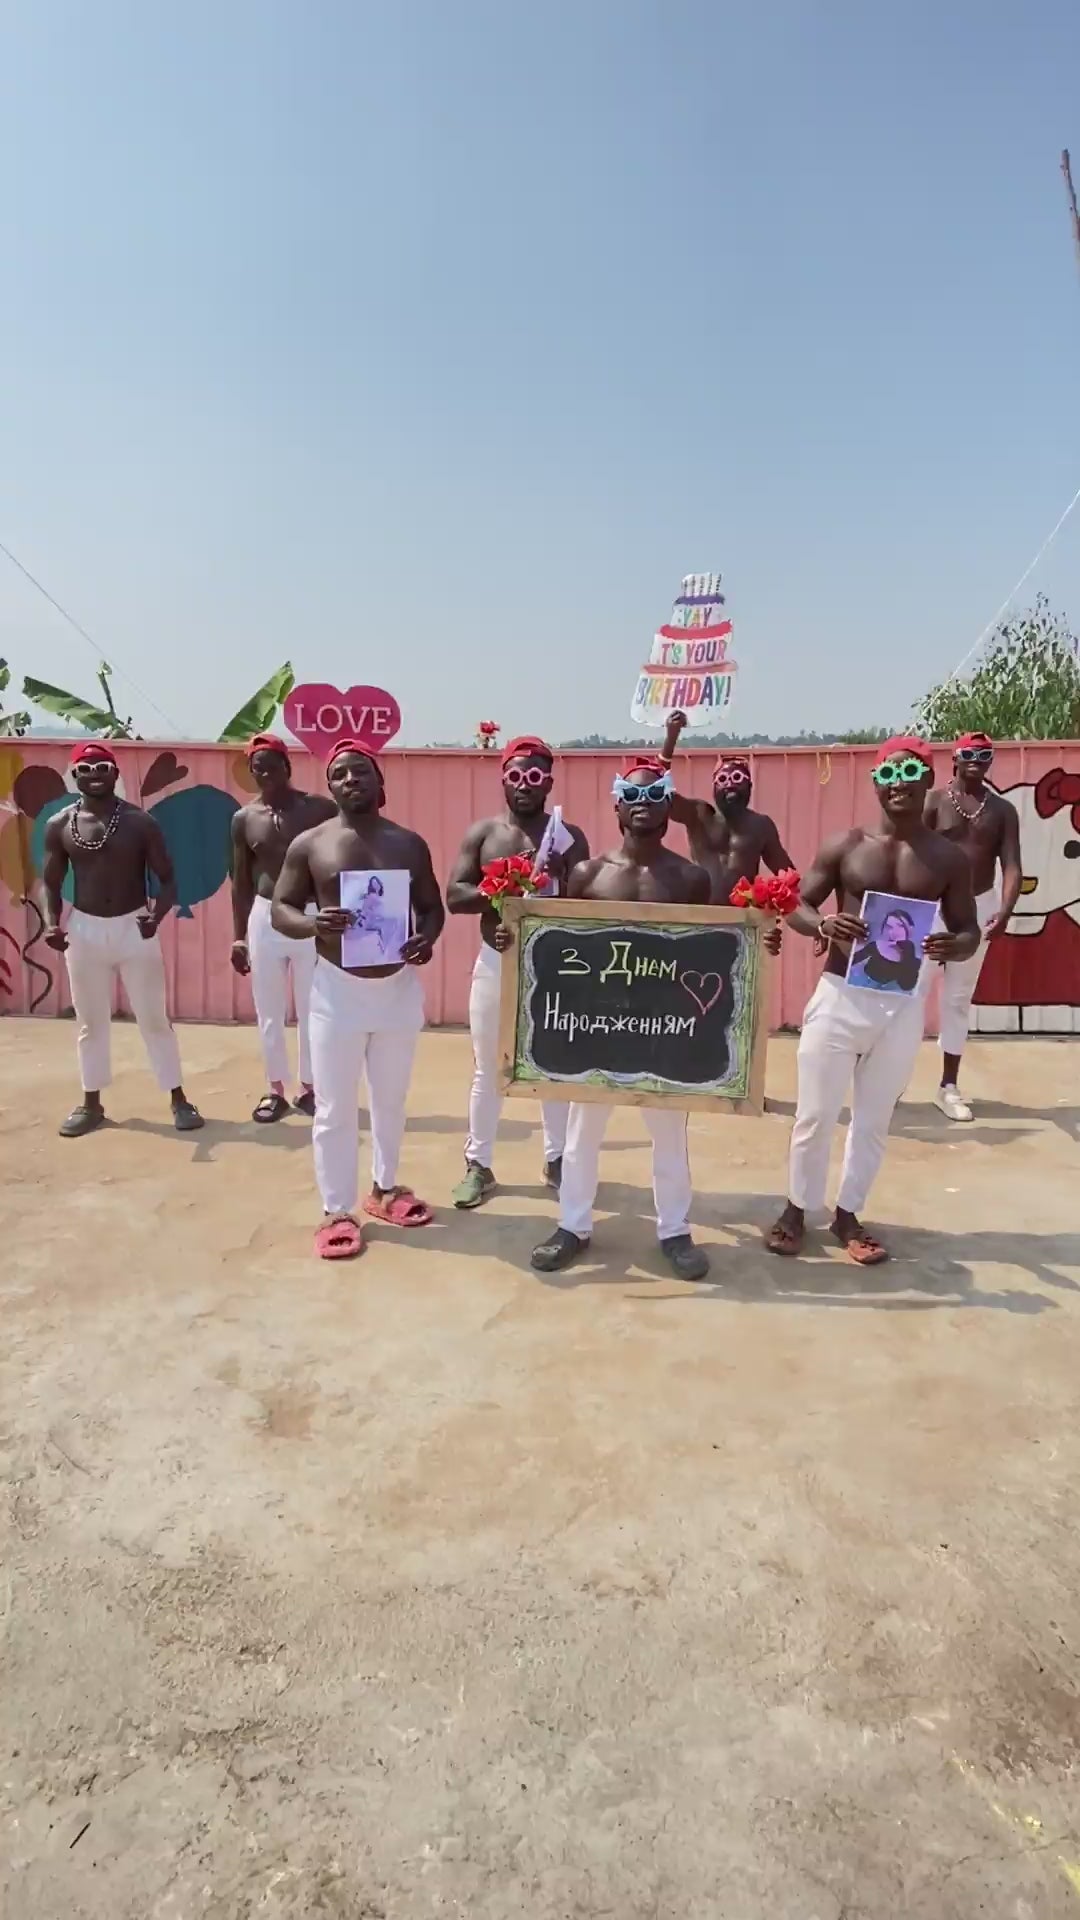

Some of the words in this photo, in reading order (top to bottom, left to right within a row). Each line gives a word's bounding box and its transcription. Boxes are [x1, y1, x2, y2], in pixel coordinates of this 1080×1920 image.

[683, 607, 713, 628] YAY
[656, 642, 683, 666] T'S
[686, 639, 728, 665] YOUR
[635, 675, 732, 708] BIRTHDAY!
[294, 703, 392, 735] LOVE
[600, 941, 677, 986] Днем
[544, 991, 697, 1043] Народженням
